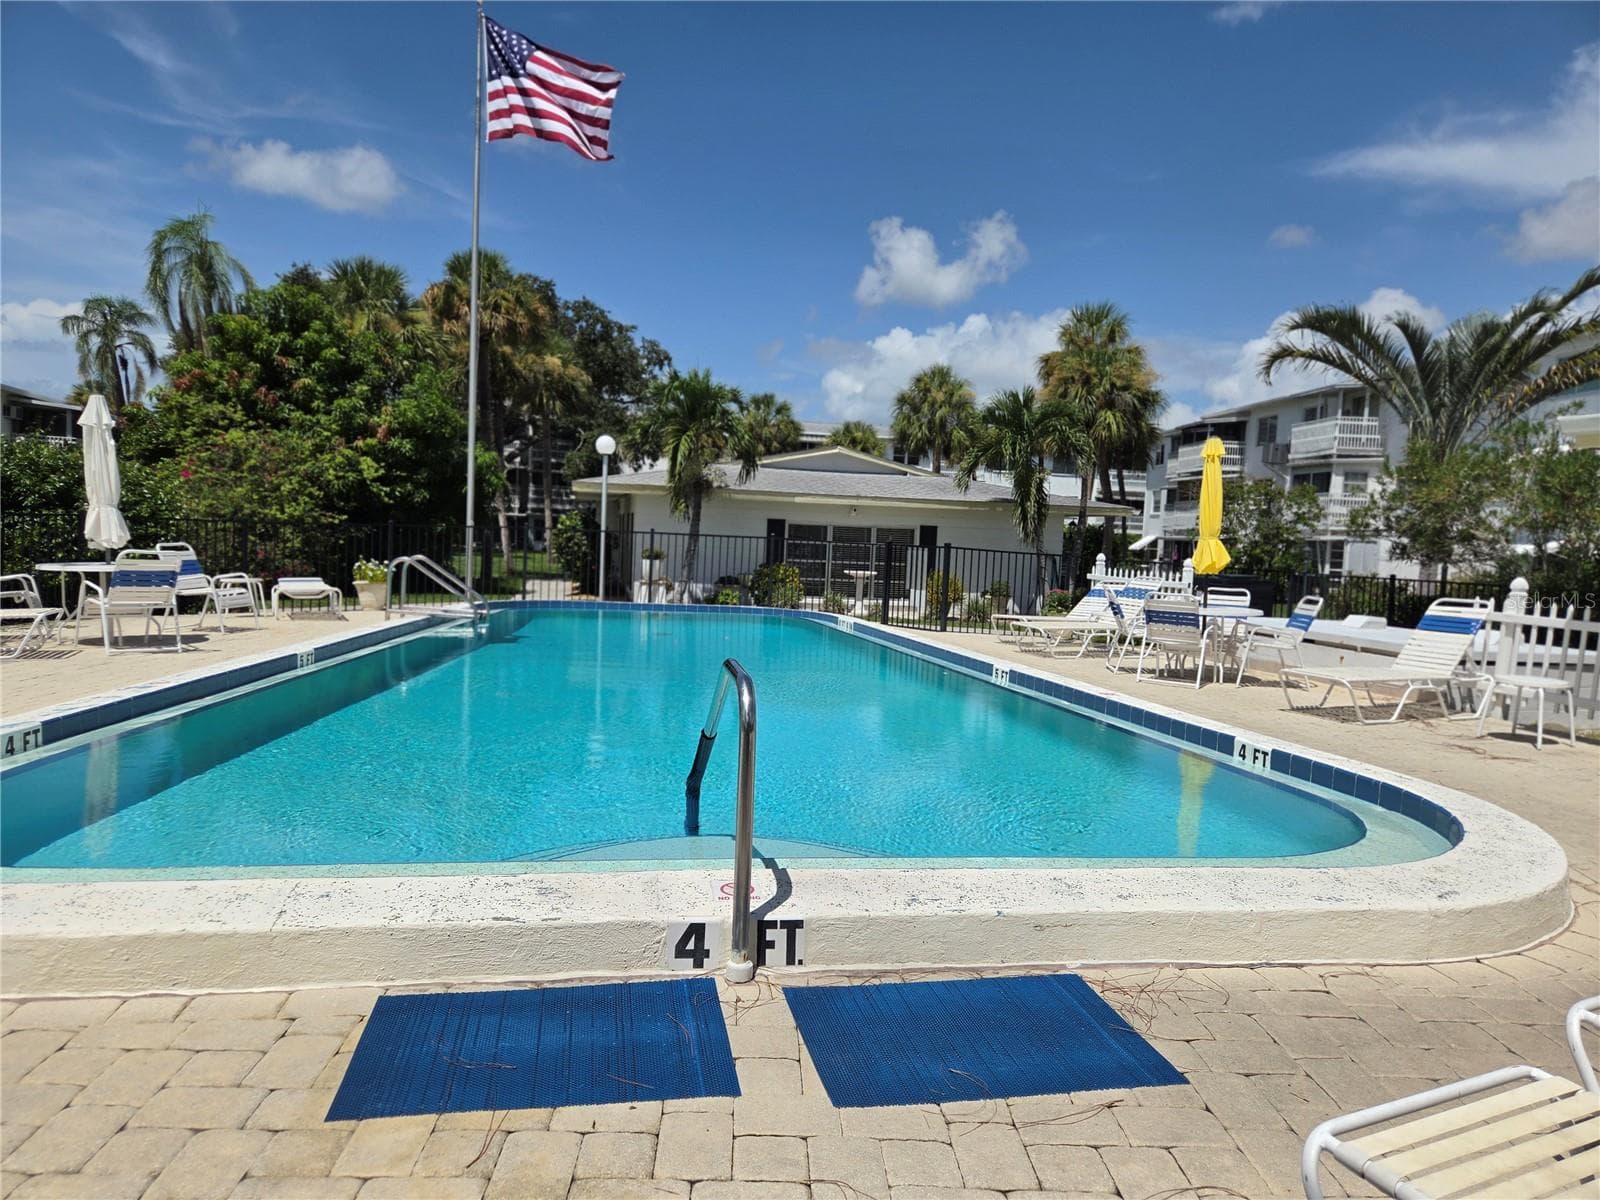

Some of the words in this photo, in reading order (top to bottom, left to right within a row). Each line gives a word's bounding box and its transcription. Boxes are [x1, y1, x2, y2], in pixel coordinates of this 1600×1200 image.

[1001, 670, 1008, 681] FT
[5, 735, 15, 756] 4
[23, 728, 40, 752] FT
[1239, 744, 1246, 760] 4
[1253, 748, 1269, 768] FT
[674, 923, 710, 969] 4
